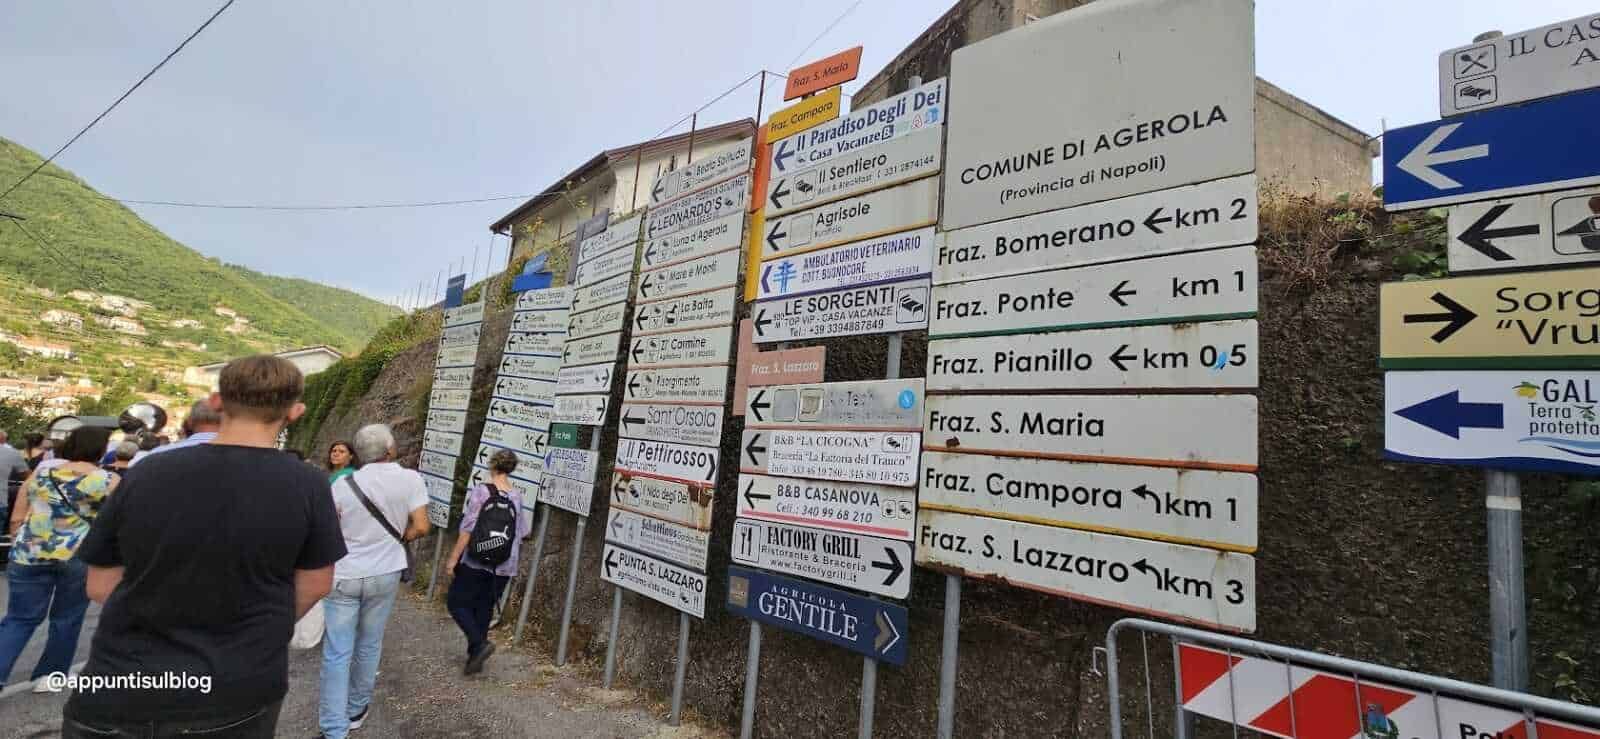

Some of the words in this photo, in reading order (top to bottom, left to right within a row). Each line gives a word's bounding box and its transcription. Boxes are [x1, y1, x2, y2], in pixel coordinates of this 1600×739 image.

[1507, 37, 1537, 58] IL
[813, 71, 821, 81] S.
[823, 61, 849, 77] Maria
[770, 118, 788, 132] Fraz.
[791, 101, 833, 124] Campora
[797, 134, 806, 151] Il
[810, 116, 865, 147] Paradiso
[866, 97, 907, 127] Degli
[913, 84, 941, 111] Dei
[810, 147, 832, 162] Casa
[837, 130, 881, 154] Vacanze
[960, 147, 1056, 185] COMUNE
[1062, 139, 1085, 161] DI
[1094, 104, 1228, 153] AGEROLA
[818, 171, 826, 184] Il
[829, 153, 887, 181] Sentiero
[999, 176, 1074, 205] (Provincia
[1080, 168, 1095, 186] di
[1100, 155, 1166, 182] Napoli)
[657, 196, 723, 231] LEONARDO'S
[815, 202, 871, 229] Agrisole
[938, 244, 986, 266] Fraz.
[995, 219, 1135, 257] Bomerano
[1175, 205, 1219, 228] km
[1230, 198, 1247, 220] 2
[803, 248, 859, 269] AMBULATORIO
[860, 235, 921, 257] VETERINARIO
[784, 299, 802, 316] LE
[807, 286, 895, 313] SORGENTI
[936, 299, 987, 320] Fraz.
[998, 286, 1074, 315] Ponte
[1172, 275, 1219, 298] km
[1234, 270, 1245, 292] 1
[801, 314, 815, 325] VIP
[822, 309, 847, 323] CASA
[847, 305, 894, 320] VACANZE
[808, 323, 825, 335] +39
[932, 354, 984, 375] Fraz.
[994, 347, 1093, 373] Pianillo
[1143, 348, 1189, 369] km
[1543, 378, 1599, 404] GAL
[648, 405, 717, 428] Sant'Orsola
[929, 410, 981, 433] Fraz.
[990, 411, 1010, 434] S.
[1019, 412, 1105, 437] Maria
[1528, 402, 1572, 419] Terra
[774, 435, 795, 445] B&B
[1530, 419, 1600, 437] protetta
[626, 441, 636, 458] Il
[638, 442, 707, 468] Pettirosso
[854, 453, 869, 465] del
[893, 472, 909, 482] 975
[777, 484, 801, 499] B&B
[804, 487, 880, 507] CASANOVA
[925, 467, 976, 493] Fraz.
[986, 472, 1122, 509] Campora
[1165, 492, 1212, 519] km
[1226, 498, 1238, 522] 1
[802, 505, 820, 518] 340
[821, 507, 833, 518] 99
[836, 508, 850, 521] 68
[853, 511, 873, 524] 210
[476, 535, 505, 553] PUMA
[767, 526, 818, 552] FACTORY
[822, 536, 862, 559] GRILL
[760, 544, 809, 561] Ristorante
[812, 553, 819, 563] &
[823, 555, 867, 573] Braceria
[769, 558, 858, 583] www.factorygrill.it
[920, 525, 973, 555] Fraz.
[982, 534, 1002, 561] S.
[1013, 539, 1129, 583] Lazzaro
[1163, 566, 1213, 600] km
[1225, 578, 1245, 605] 3
[619, 552, 647, 572] PUNTA
[648, 562, 656, 577] S.
[658, 567, 704, 593] LAZZARO
[771, 584, 847, 611] AGRICOLA
[758, 591, 859, 642] GENTILE
